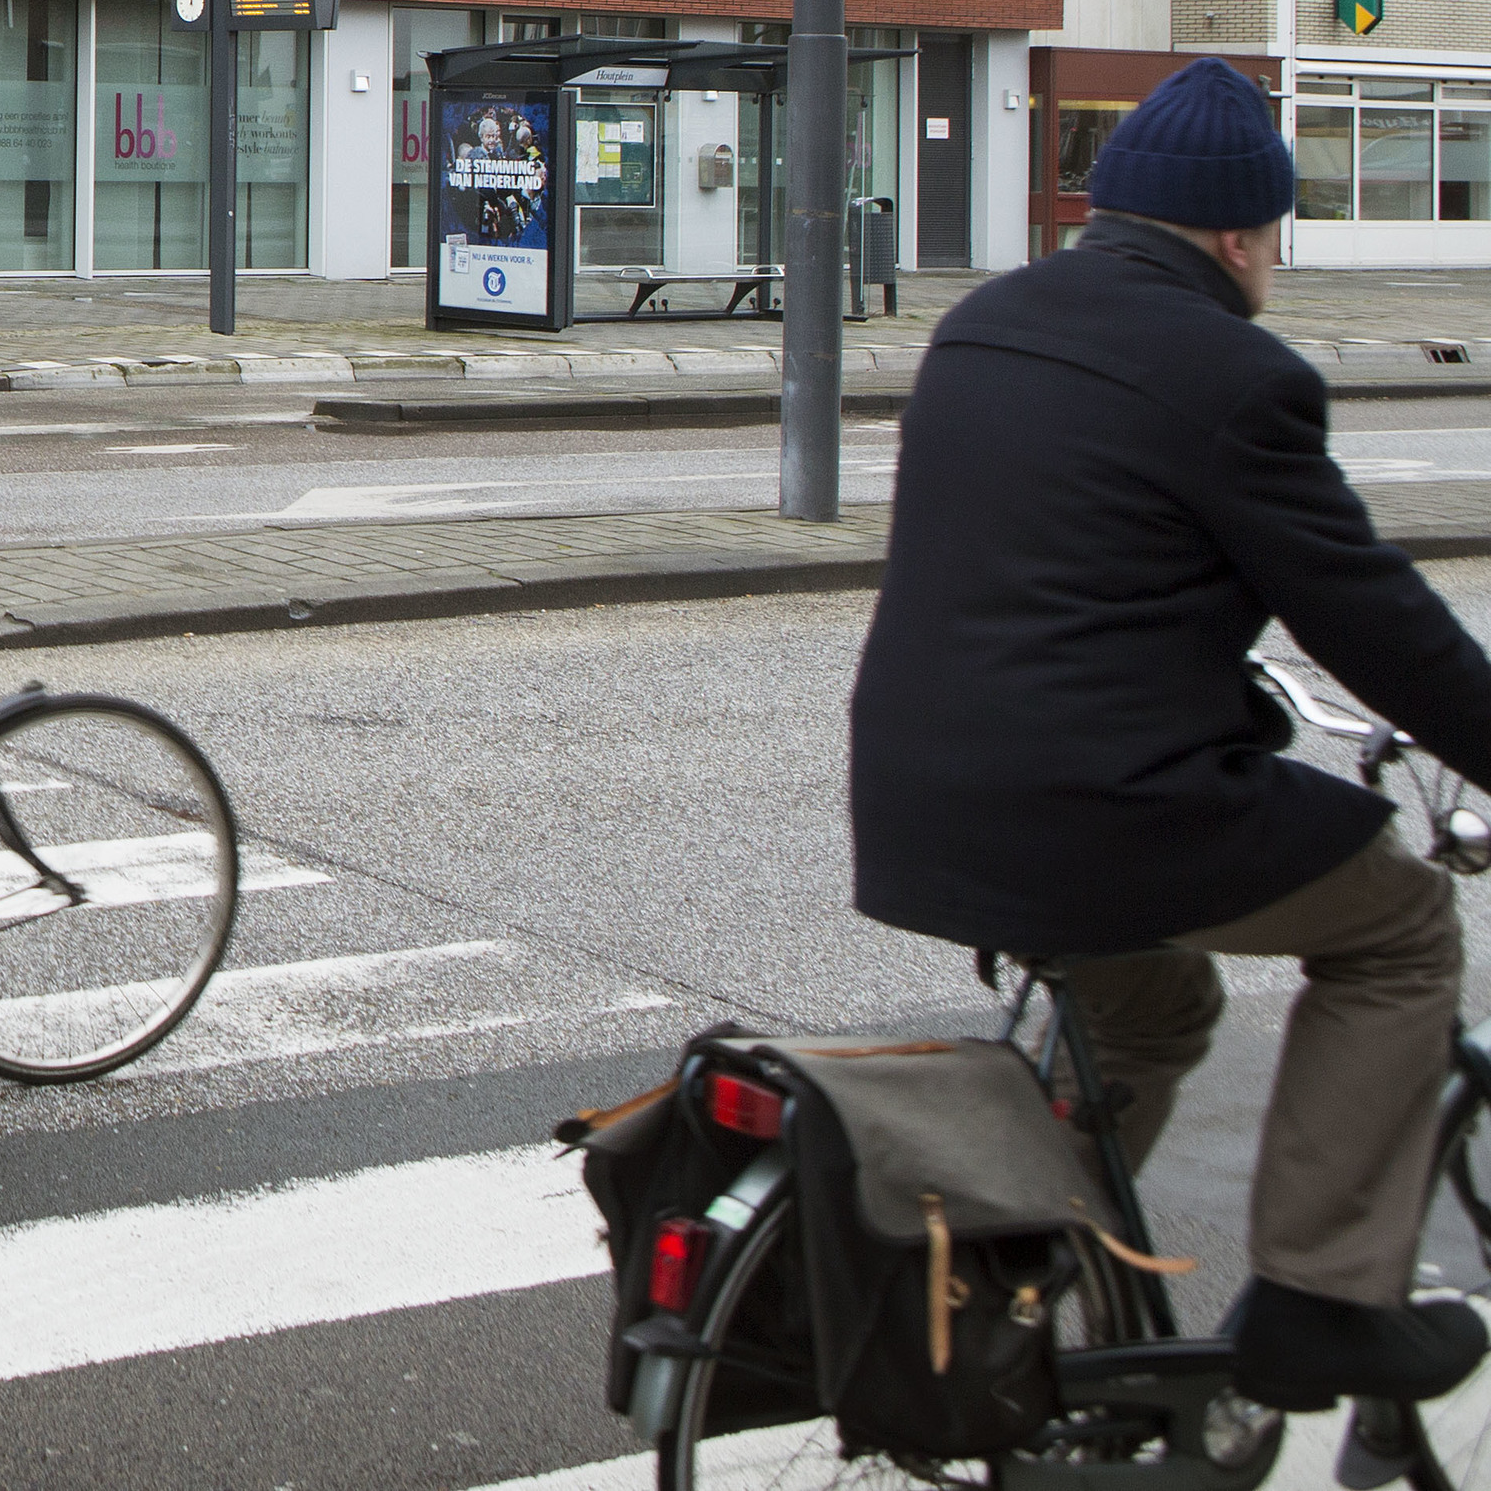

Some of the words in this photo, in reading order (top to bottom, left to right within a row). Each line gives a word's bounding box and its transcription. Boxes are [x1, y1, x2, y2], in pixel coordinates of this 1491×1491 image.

[595, 70, 634, 86] Houtplein
[114, 92, 177, 159] bbb
[455, 159, 472, 173] DE
[473, 160, 535, 175] STEMMING
[449, 173, 472, 187] VAN
[474, 175, 542, 190] NEDERLAND
[487, 254, 509, 262] WEKEN
